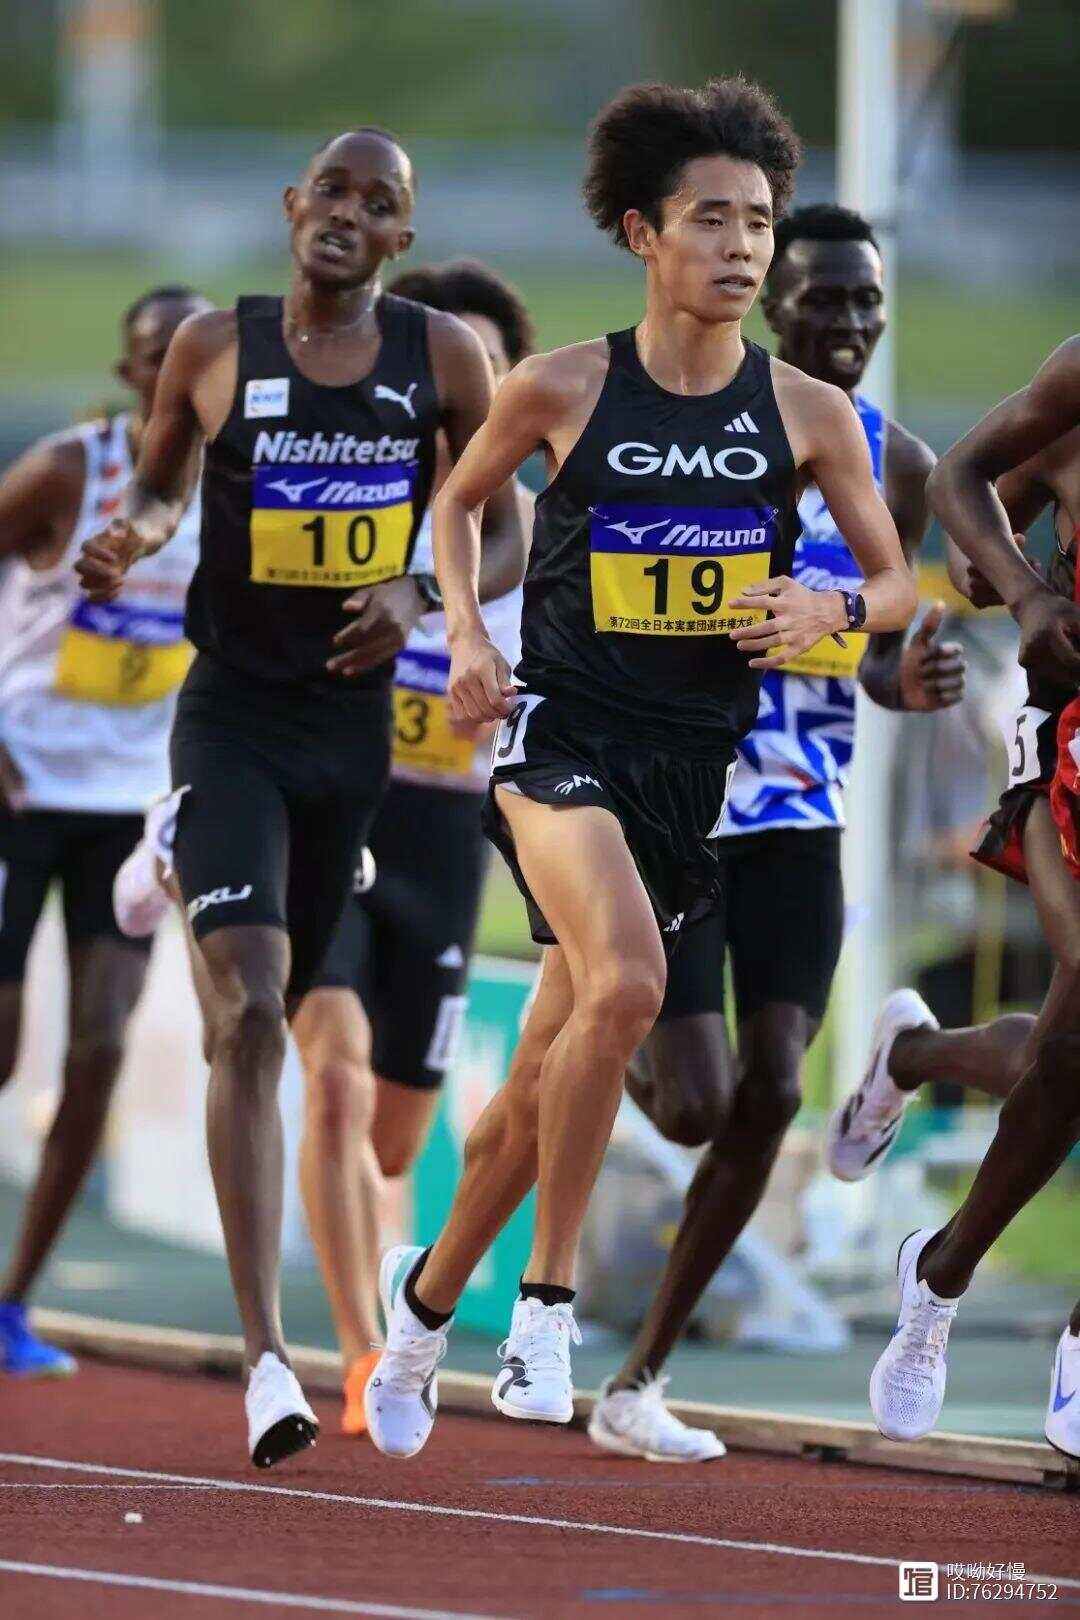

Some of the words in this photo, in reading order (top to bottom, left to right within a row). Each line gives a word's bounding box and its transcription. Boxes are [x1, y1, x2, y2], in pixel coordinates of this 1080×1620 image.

[252, 430, 420, 465] Nishitetsu
[606, 442, 768, 480] GMO
[302, 515, 377, 566] 10
[643, 558, 725, 616] 19
[398, 697, 429, 745] 3
[1011, 713, 1027, 777] 5
